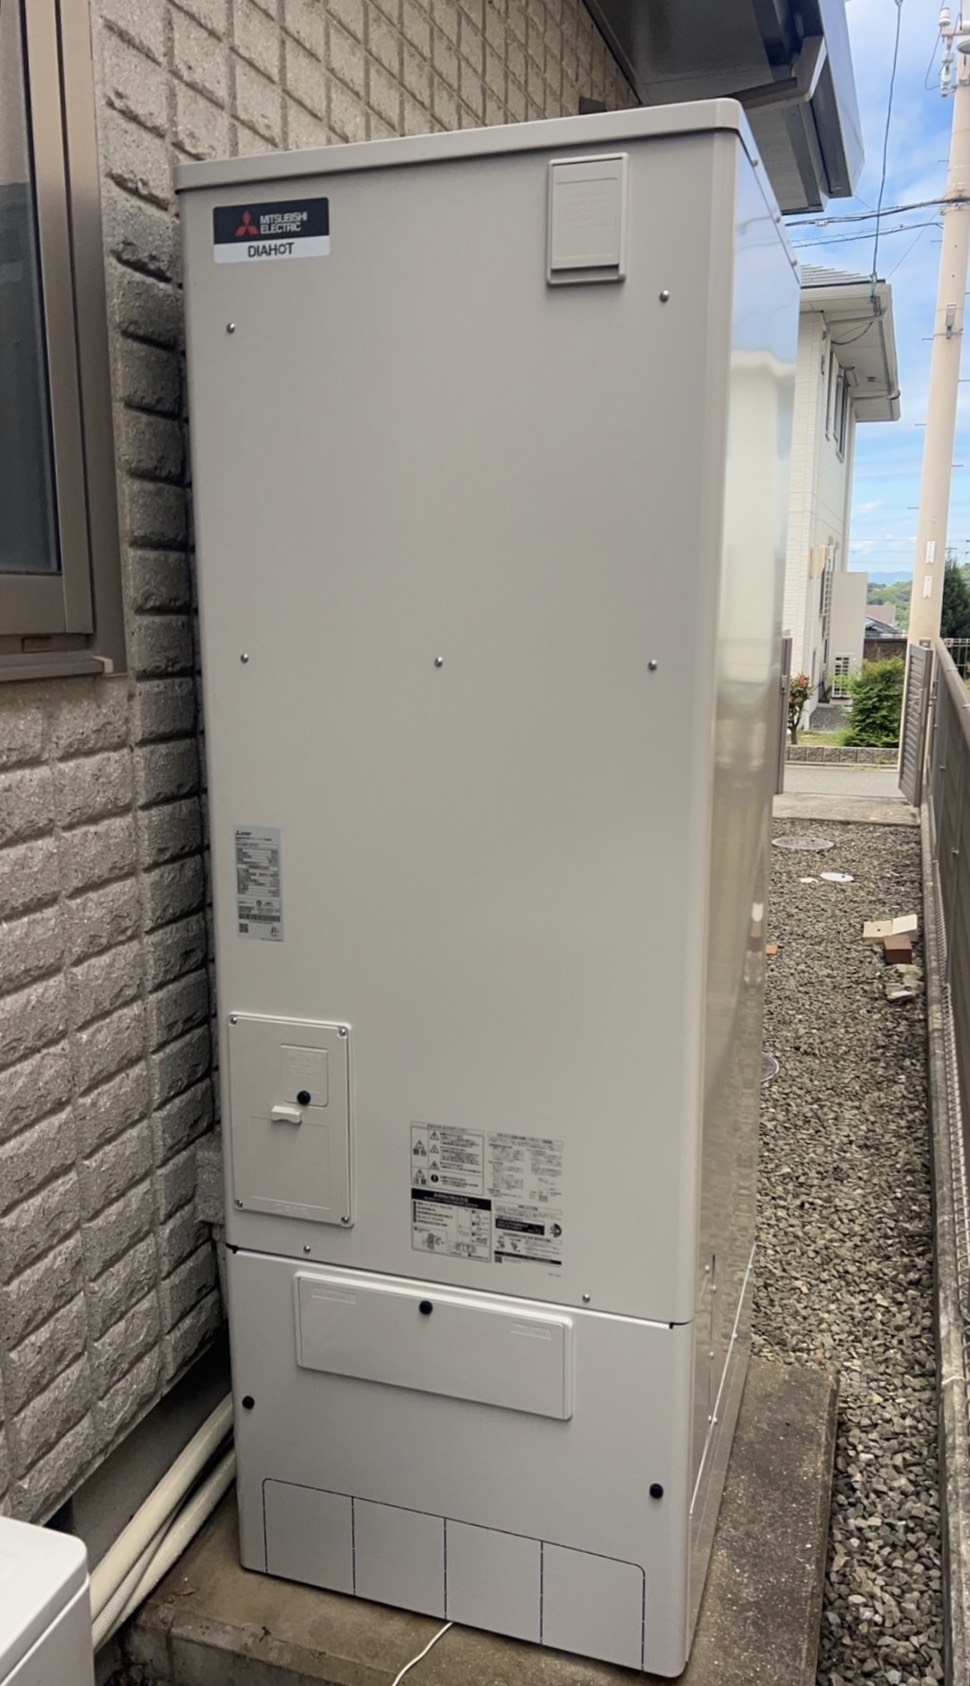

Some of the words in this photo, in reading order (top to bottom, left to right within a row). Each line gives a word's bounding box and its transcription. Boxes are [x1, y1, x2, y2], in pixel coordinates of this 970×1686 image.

[260, 211, 307, 224] MITSUBISHI
[260, 222, 301, 234] ELECTRIC
[248, 242, 294, 257] DIAHOT
